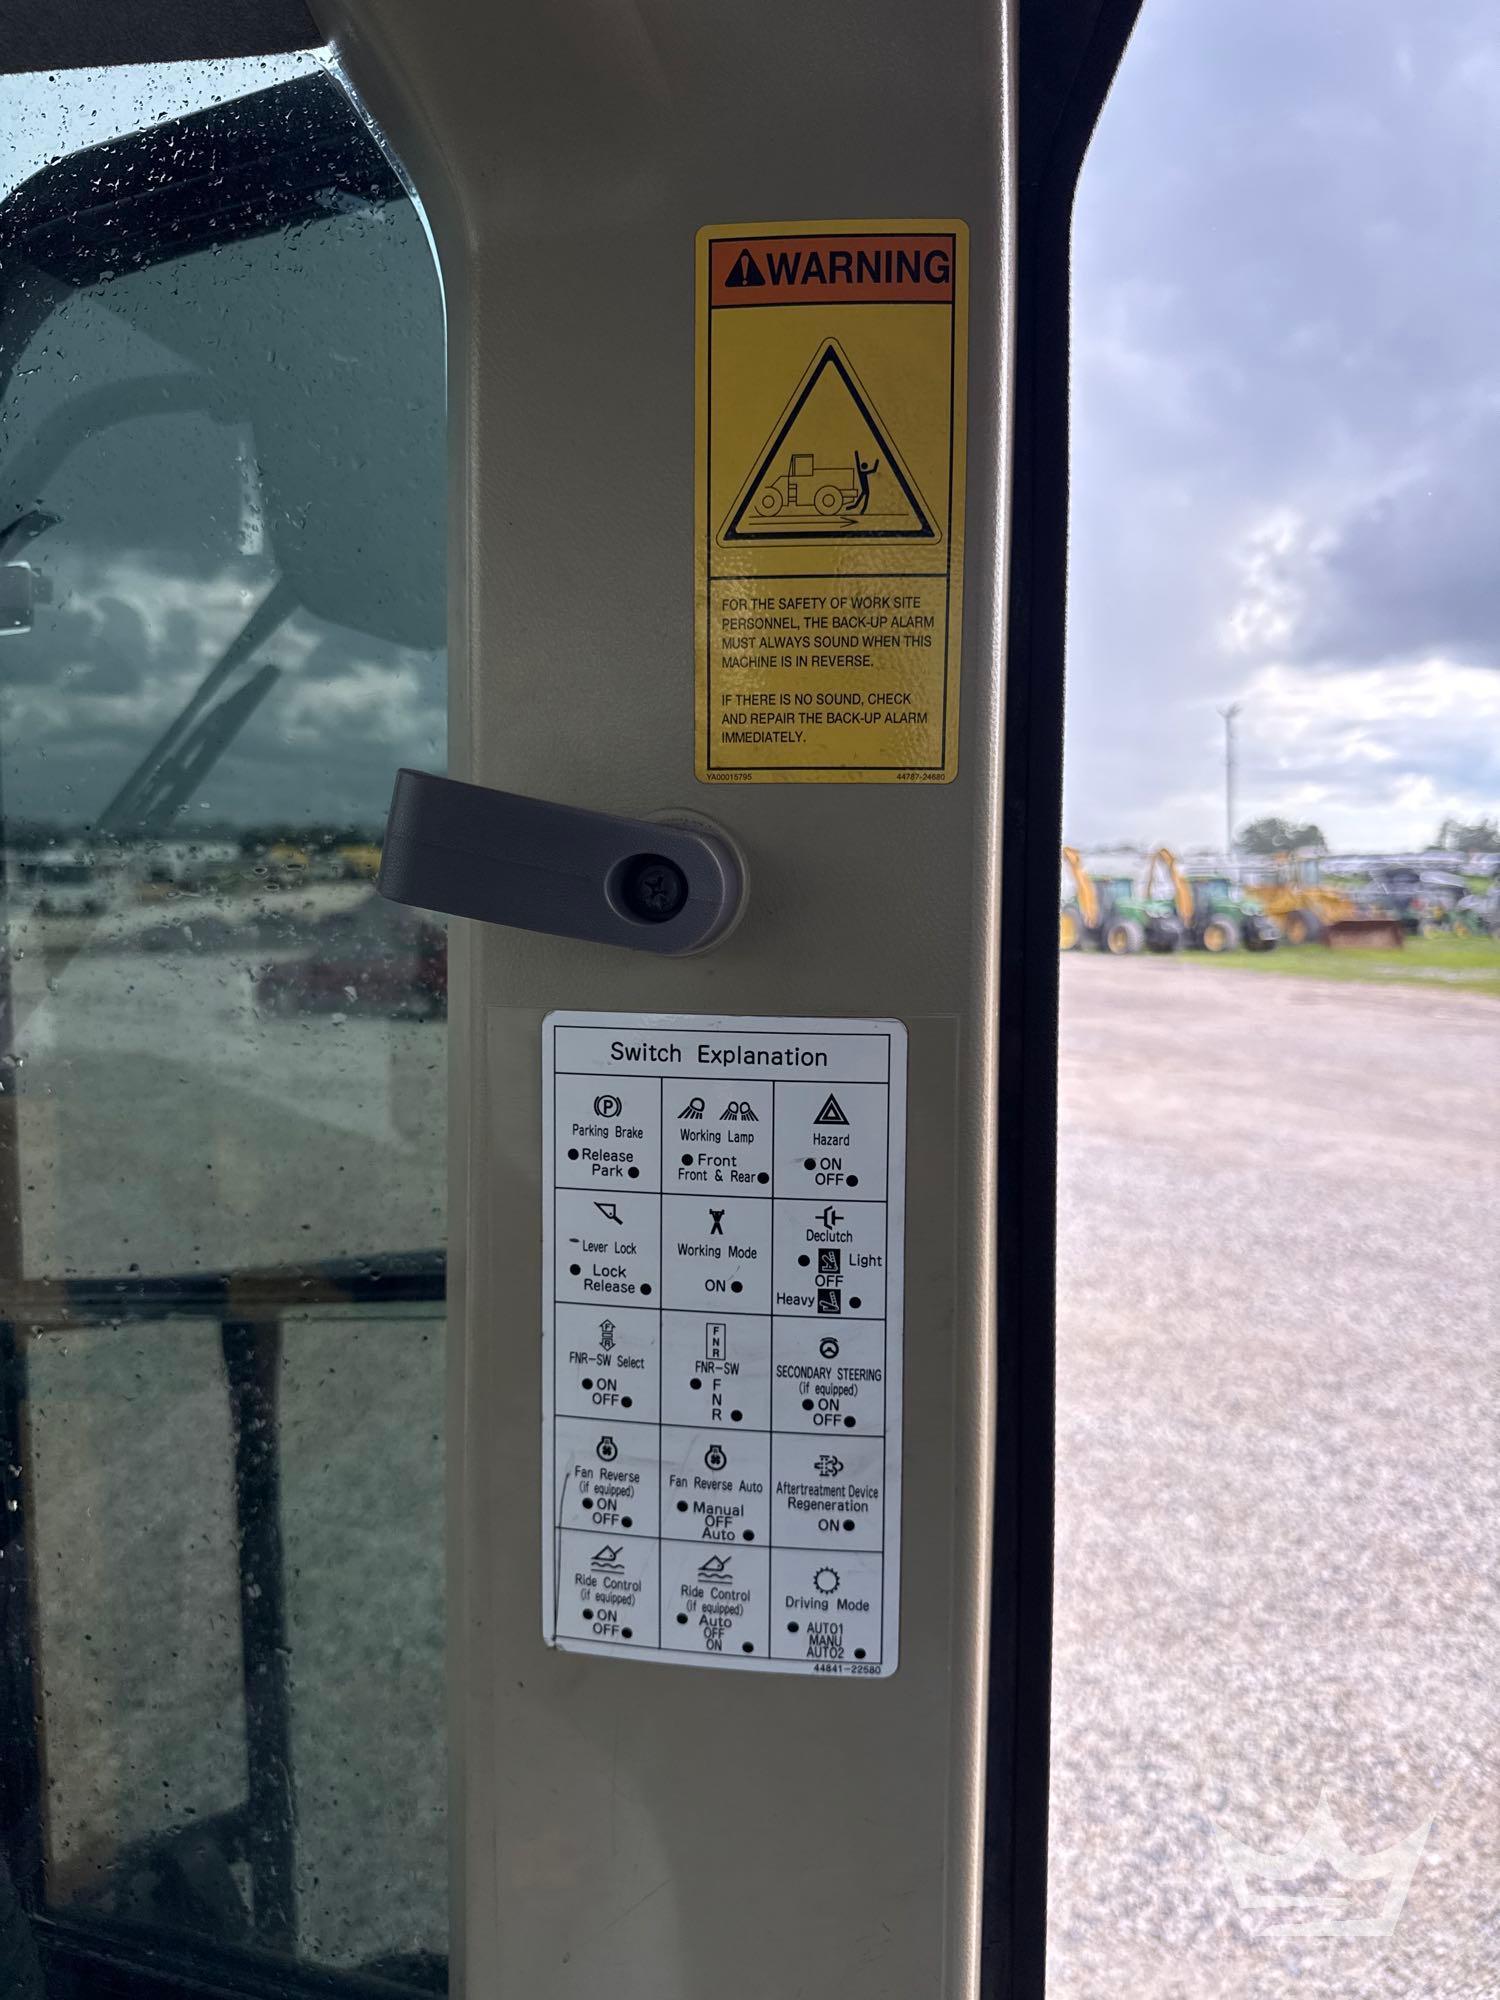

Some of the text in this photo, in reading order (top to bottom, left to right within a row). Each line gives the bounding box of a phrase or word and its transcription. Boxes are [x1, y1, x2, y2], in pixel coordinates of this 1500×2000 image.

[767, 250, 950, 285] WARNING
[722, 596, 921, 611] FOR THE SAFETY OF WORK SITE
[722, 616, 934, 630] PERSONNEL, THE BACK-UP ALARM
[722, 635, 932, 649] MUST ALWAYS SOUND WHEN THIS
[722, 655, 874, 668] MACHINE IS IN REVERSE.
[722, 693, 911, 706] IF THERE IS NO SOUND, CHECK
[722, 712, 928, 725] AND REPAIR THE BACK-UP ALARM
[722, 731, 807, 744] IMMEDIATELY.
[610, 1041, 828, 1067] Switch Explanation
[572, 1124, 643, 1139] Parking Brake
[681, 1128, 754, 1144] Working Lamp
[813, 1133, 850, 1147] Hazard
[582, 1149, 634, 1163] Release
[698, 1154, 737, 1166] Front
[592, 1164, 623, 1177] Park
[820, 1158, 841, 1170] ON
[678, 1168, 755, 1183] Front & Rear
[815, 1173, 844, 1186] OFF
[806, 1230, 853, 1243] Declutch
[583, 1241, 637, 1255] Lever Lock
[678, 1243, 757, 1259] Working Mode
[849, 1254, 882, 1269] Light
[593, 1265, 627, 1278] Lock
[584, 1280, 635, 1294] Release
[705, 1280, 726, 1291] ON
[815, 1275, 844, 1287] OFF
[776, 1293, 815, 1308] Heavy
[713, 1327, 719, 1336] F
[713, 1338, 720, 1347] N
[713, 1349, 720, 1358] R
[570, 1352, 645, 1369] FNR-SW Select
[695, 1361, 740, 1376] FNR-SW
[776, 1365, 882, 1382] SECONDARY STEERING
[597, 1379, 617, 1391] ON
[713, 1379, 721, 1390] F
[799, 1383, 858, 1397] (if equipped)
[592, 1394, 619, 1406] OFF
[712, 1394, 722, 1405] N
[818, 1399, 839, 1411] ON
[712, 1409, 722, 1421] R
[813, 1414, 842, 1426] OFF
[575, 1466, 640, 1483] Fan Reverse
[580, 1481, 635, 1497] (if equipped)
[670, 1475, 763, 1493] Fan Reverse Auto
[776, 1481, 878, 1498] Aftertreatment Device
[597, 1498, 617, 1511] ON
[693, 1503, 744, 1517] Manual
[788, 1499, 869, 1513] Regeneration
[592, 1513, 620, 1525] OFF
[705, 1516, 732, 1528] OFF
[818, 1520, 840, 1532] ON
[702, 1528, 735, 1541] Auto
[575, 1574, 642, 1592] Ride Control
[581, 1590, 635, 1606] (if equipped)
[681, 1585, 750, 1602] Ride Control
[687, 1600, 743, 1617] (if equipped)
[785, 1596, 869, 1611] Driving Mode
[597, 1609, 617, 1621] ON
[699, 1615, 732, 1628] Auto
[592, 1623, 620, 1636] OFF
[703, 1627, 725, 1639] OFF
[807, 1622, 844, 1634] AUTO1
[706, 1639, 722, 1651] ON
[809, 1635, 843, 1646] MANU
[807, 1647, 844, 1659] AUTO2
